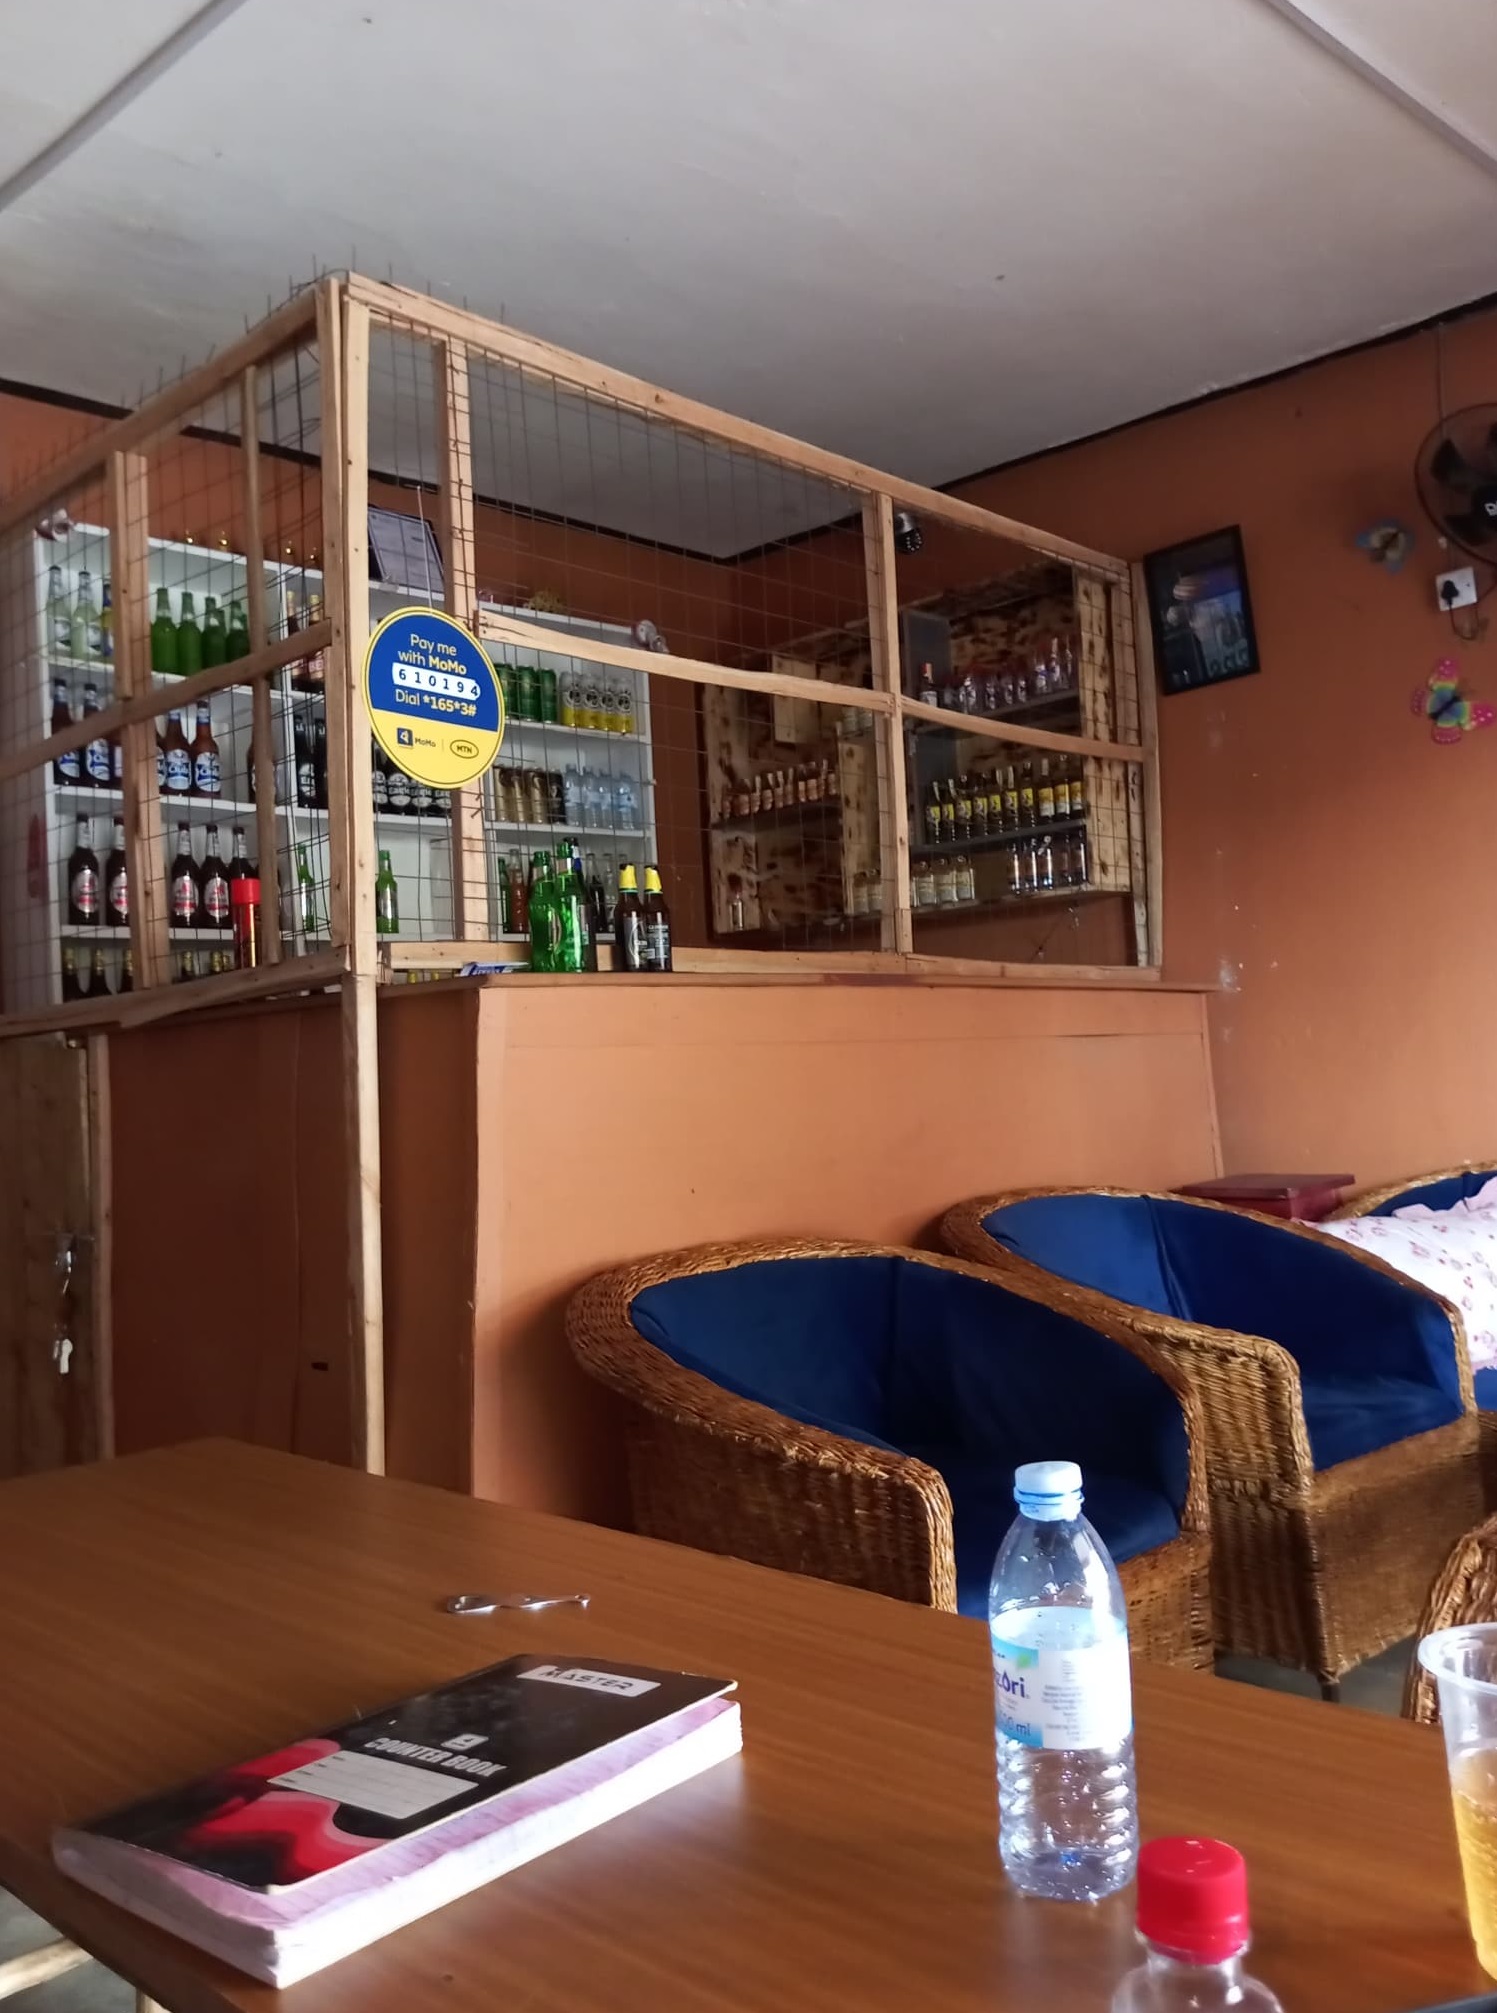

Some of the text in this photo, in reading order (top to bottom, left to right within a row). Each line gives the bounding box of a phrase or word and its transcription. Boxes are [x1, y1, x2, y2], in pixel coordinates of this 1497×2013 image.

[410, 633, 457, 656] Pay me
[397, 650, 467, 675] with MoMo
[395, 689, 420, 706] Dial
[414, 737, 437, 748] MoMo
[456, 745, 473, 754] MTN
[539, 1669, 634, 1690] MASTER
[364, 1737, 453, 1763] COUNTER
[440, 1754, 508, 1777] BOOK
